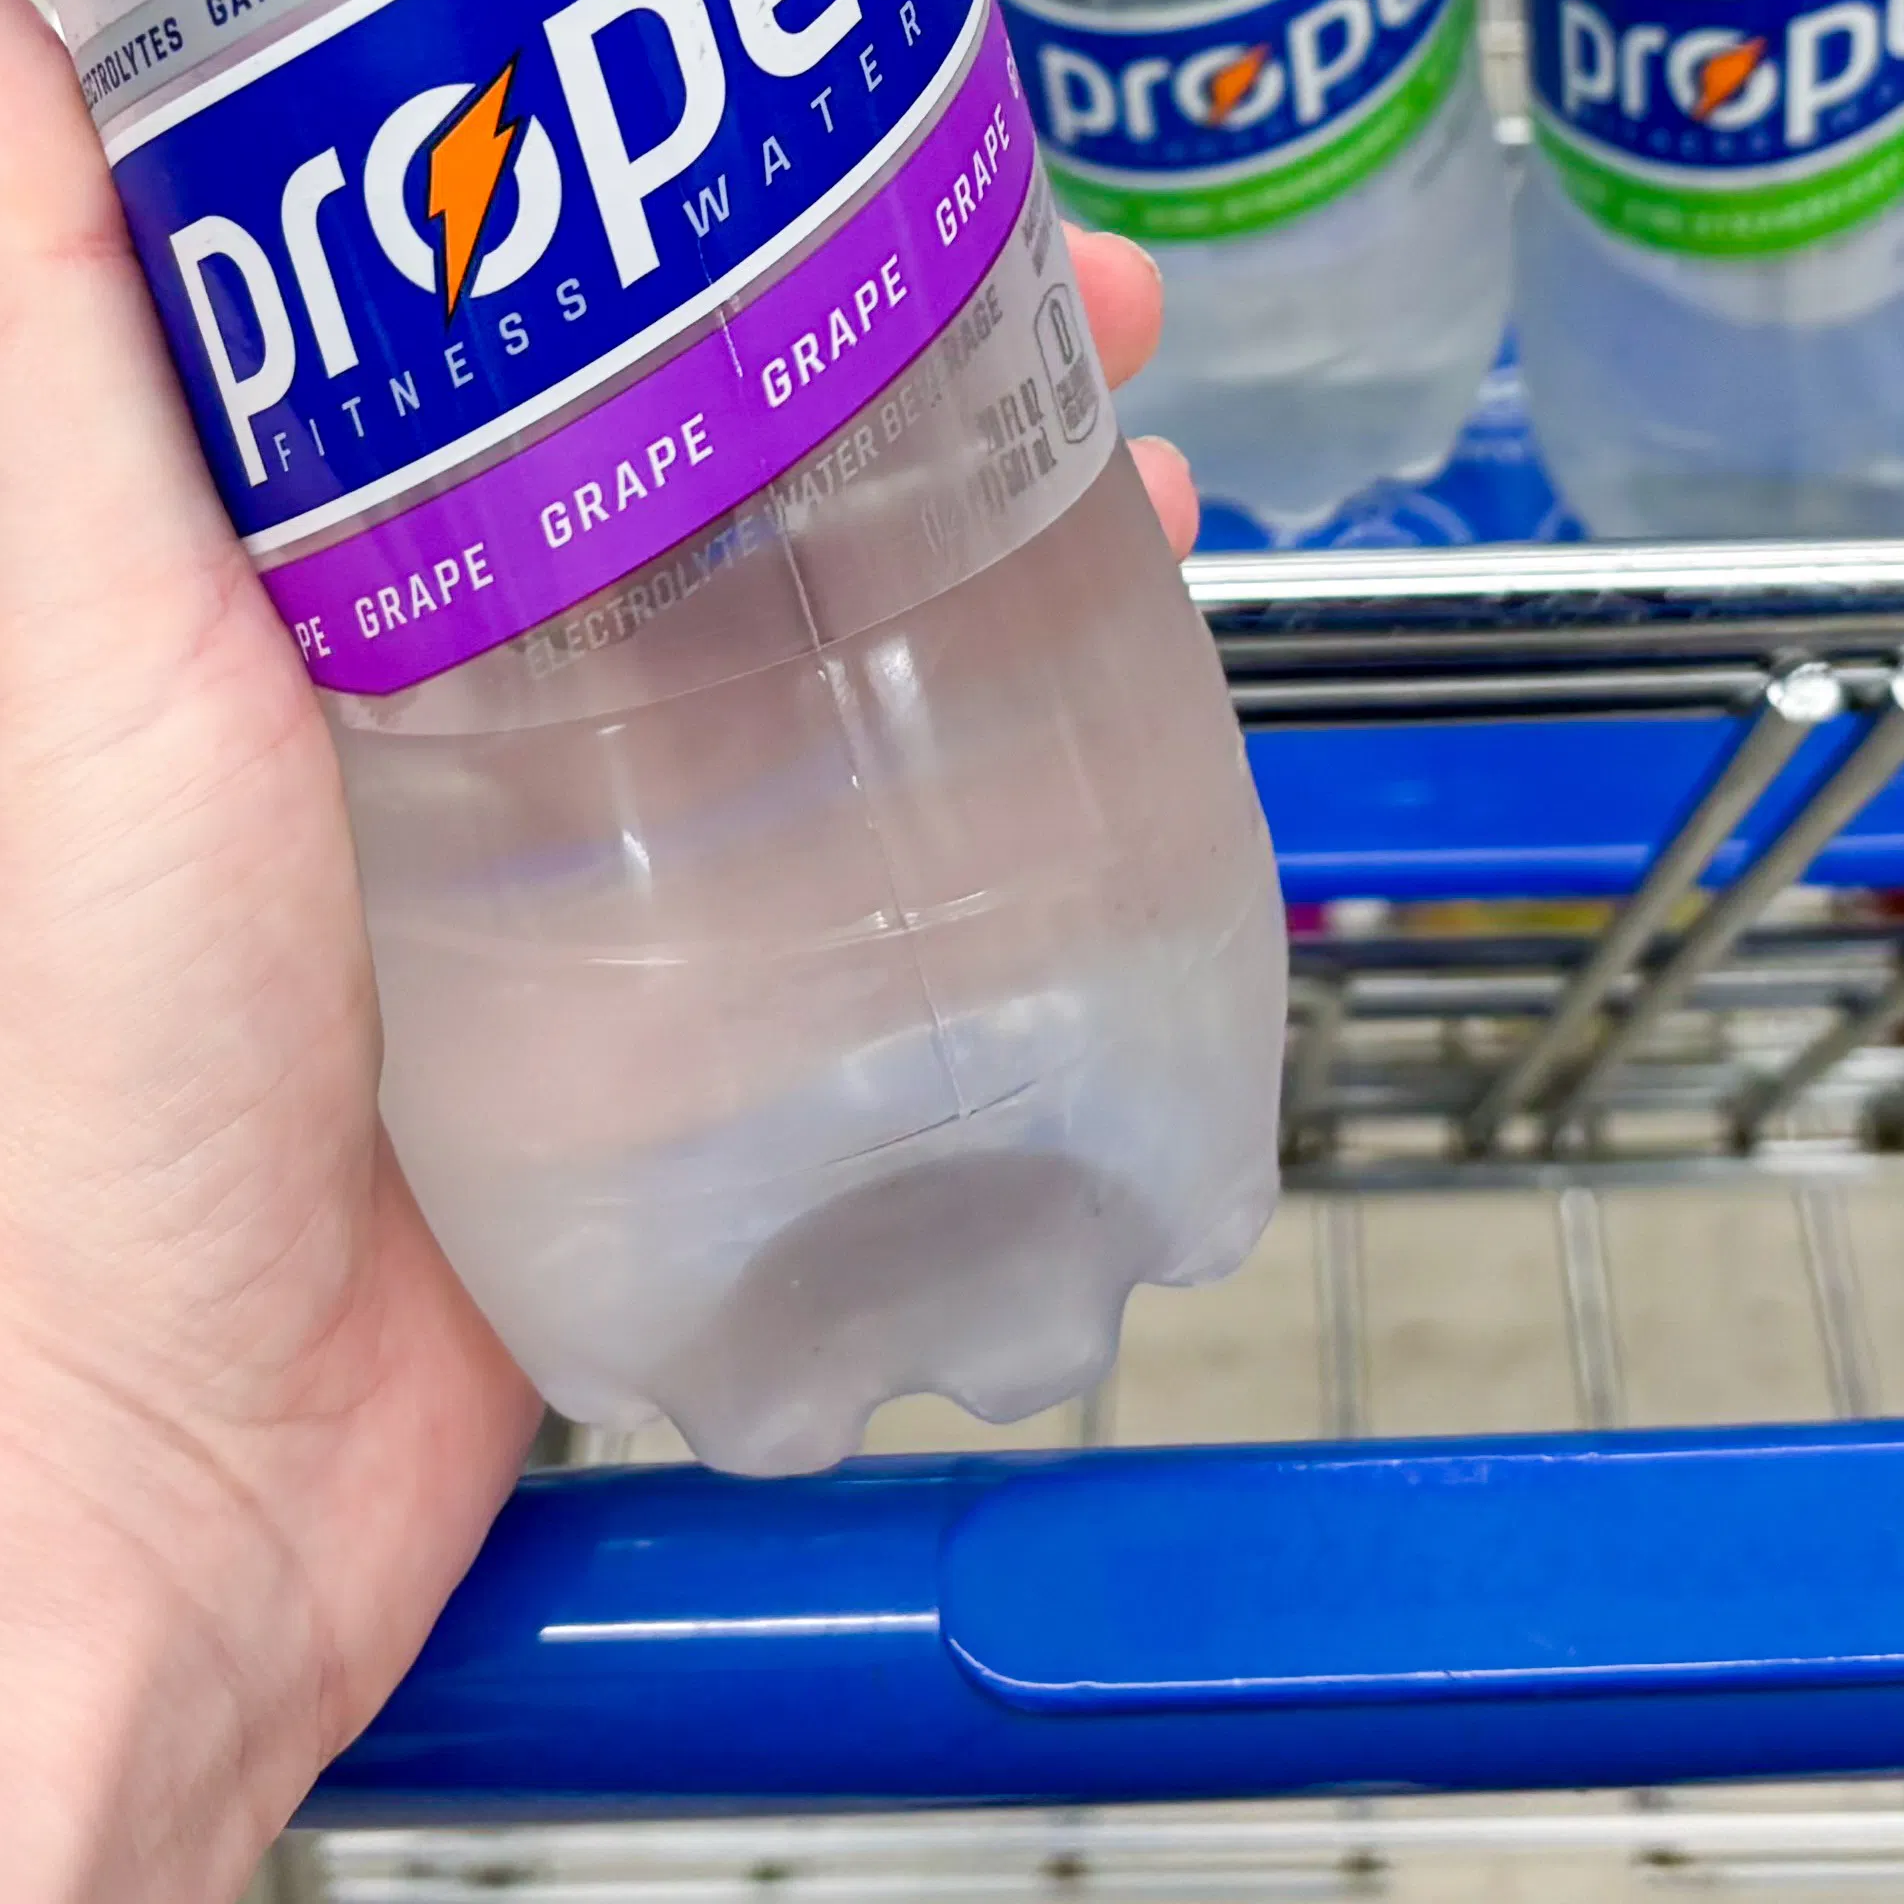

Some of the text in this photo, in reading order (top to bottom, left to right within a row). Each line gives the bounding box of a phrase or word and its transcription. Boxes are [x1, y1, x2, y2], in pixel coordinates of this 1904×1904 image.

[272, 277, 589, 473] FITNESS
[683, 0, 923, 239] WATER
[354, 543, 496, 640] GRAPE
[539, 411, 716, 550] GRAPE
[760, 254, 912, 410] GRAPE
[935, 102, 1012, 248] GRAPE
[524, 516, 759, 680] ELECTROLYTE
[764, 434, 880, 532] WATER
